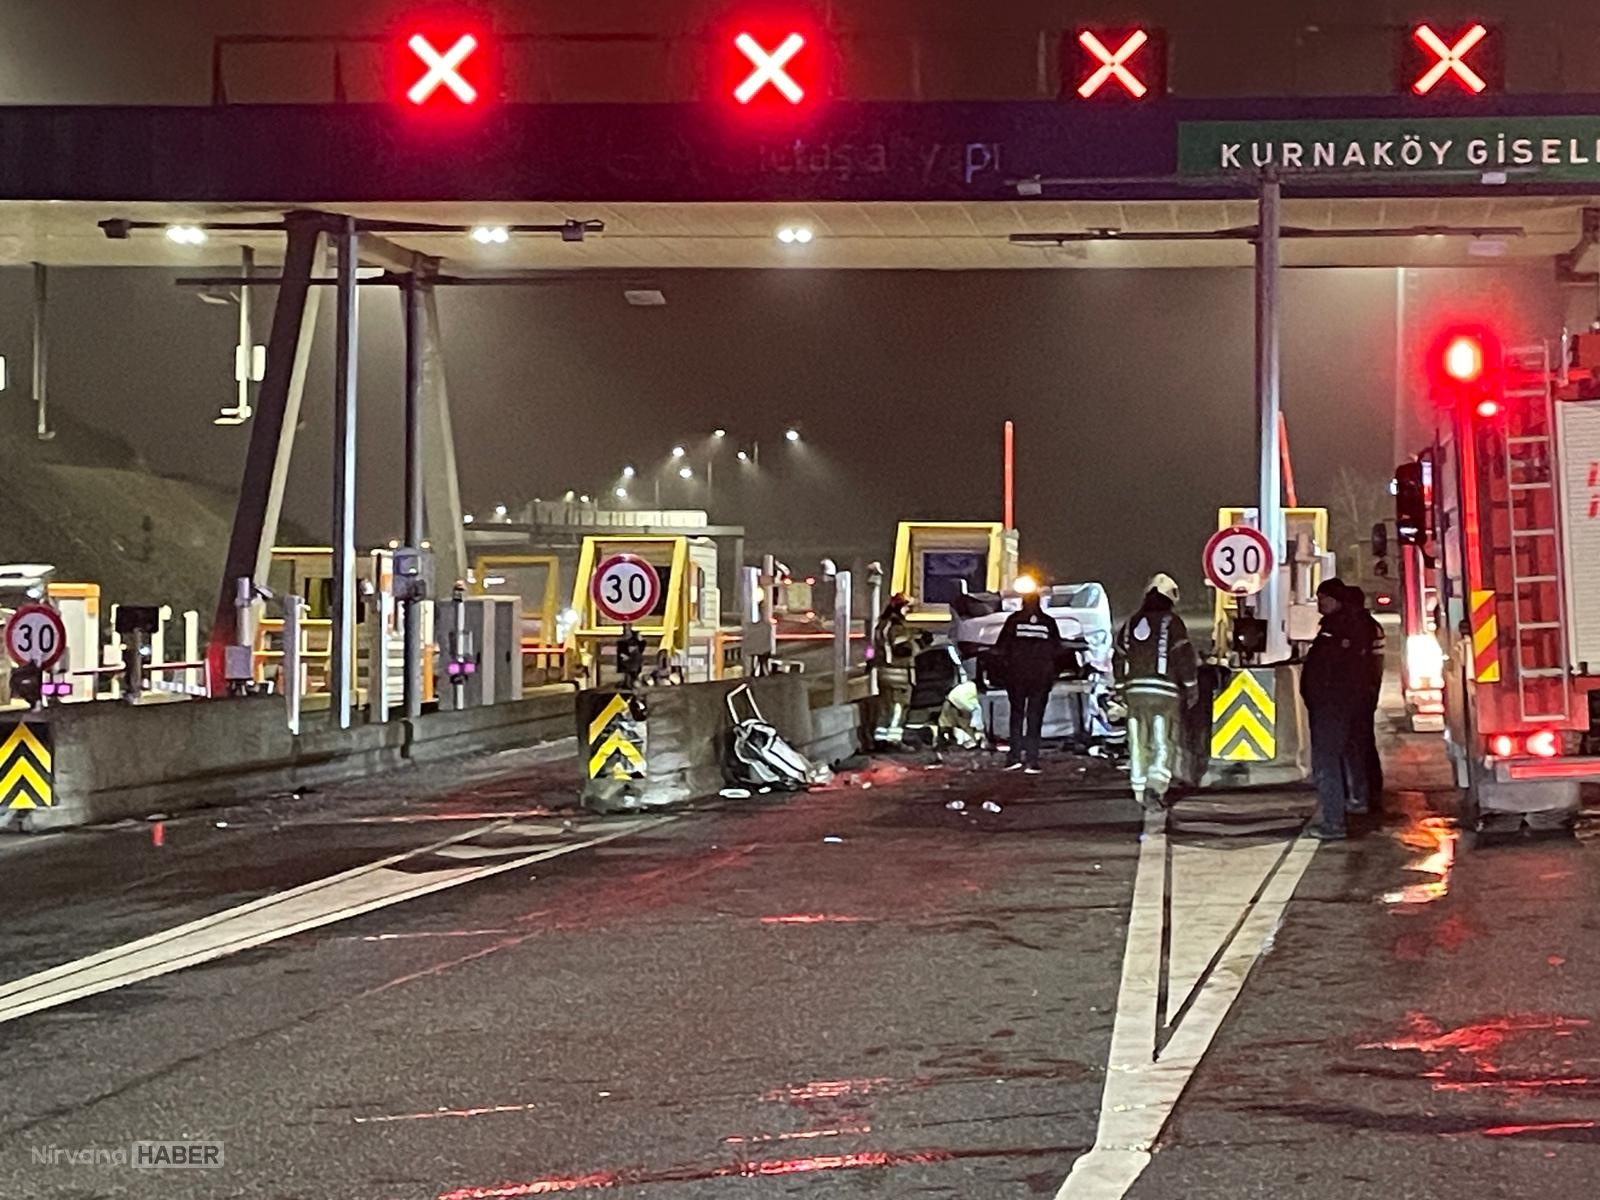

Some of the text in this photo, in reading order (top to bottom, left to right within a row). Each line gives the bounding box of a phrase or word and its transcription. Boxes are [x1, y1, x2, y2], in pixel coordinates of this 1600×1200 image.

[1221, 132, 1600, 169] KURNAKÖY GİSEL
[1219, 545, 1260, 577] 30
[606, 573, 646, 604] 30
[17, 624, 55, 653] 30
